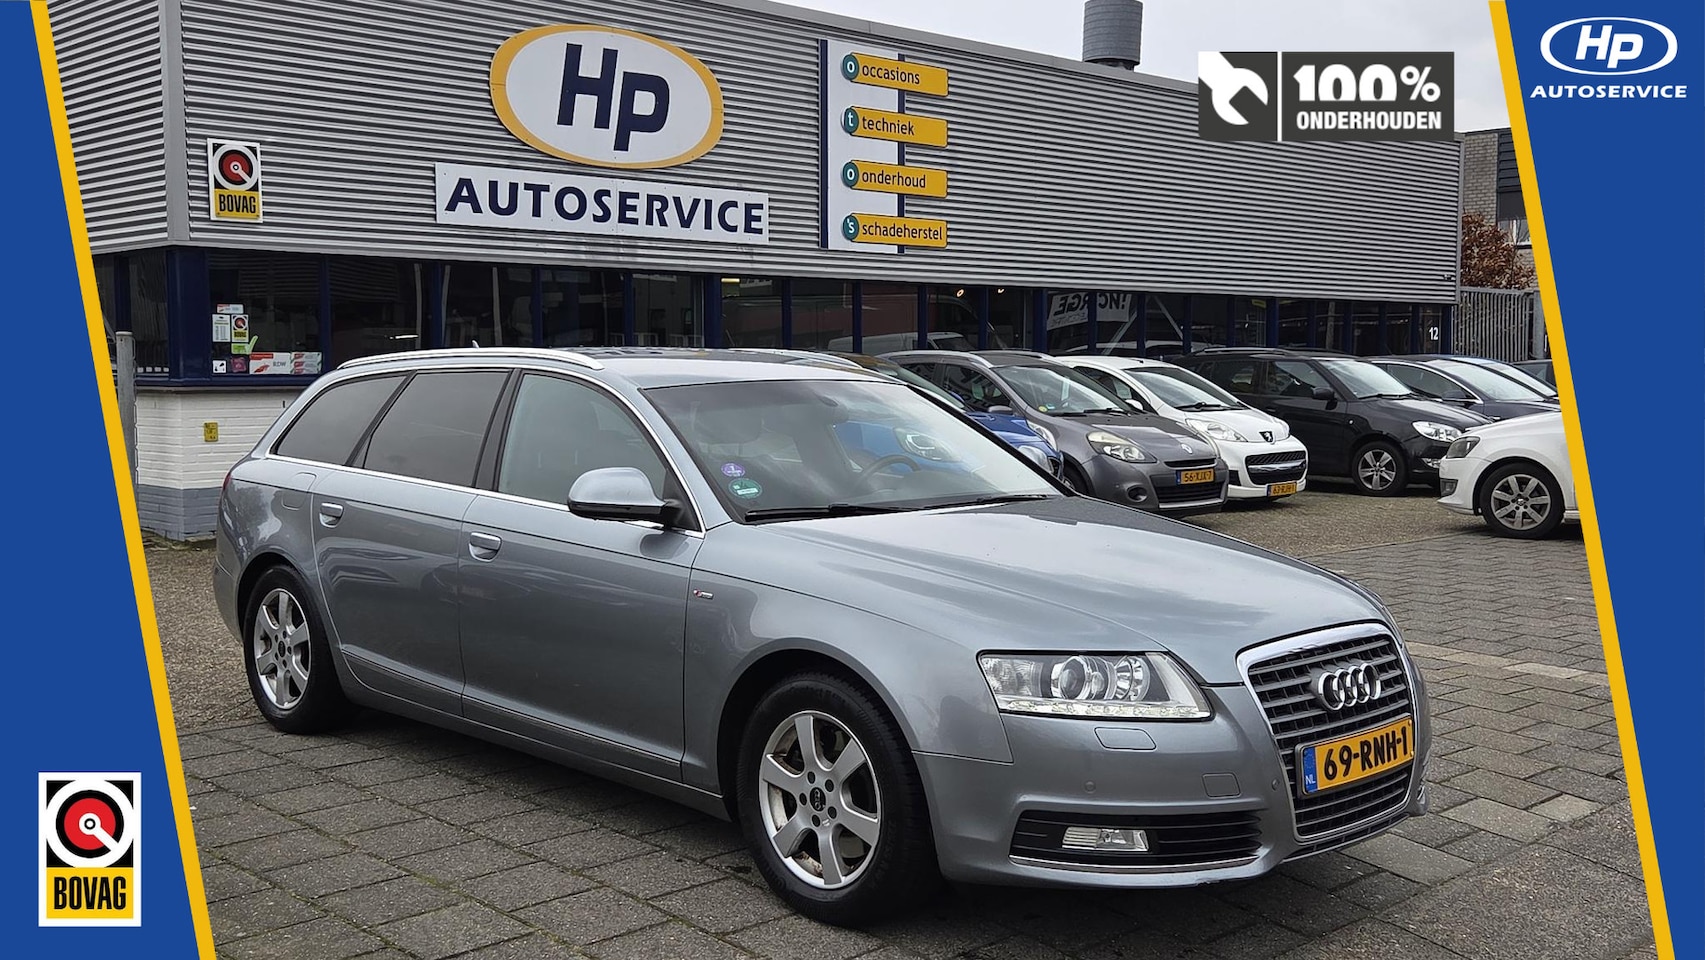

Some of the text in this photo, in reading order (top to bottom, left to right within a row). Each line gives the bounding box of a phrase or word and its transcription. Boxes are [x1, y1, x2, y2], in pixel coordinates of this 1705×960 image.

[861, 65, 920, 85] occasions
[861, 116, 915, 136] techniek
[861, 169, 926, 188] onderhoud
[218, 193, 257, 214] BOVAG
[444, 176, 765, 236] AUTOSERVICE
[861, 222, 943, 240] schadeherstel
[1428, 326, 1439, 341] 12
[1305, 726, 1408, 785] NL 69-RNH-1
